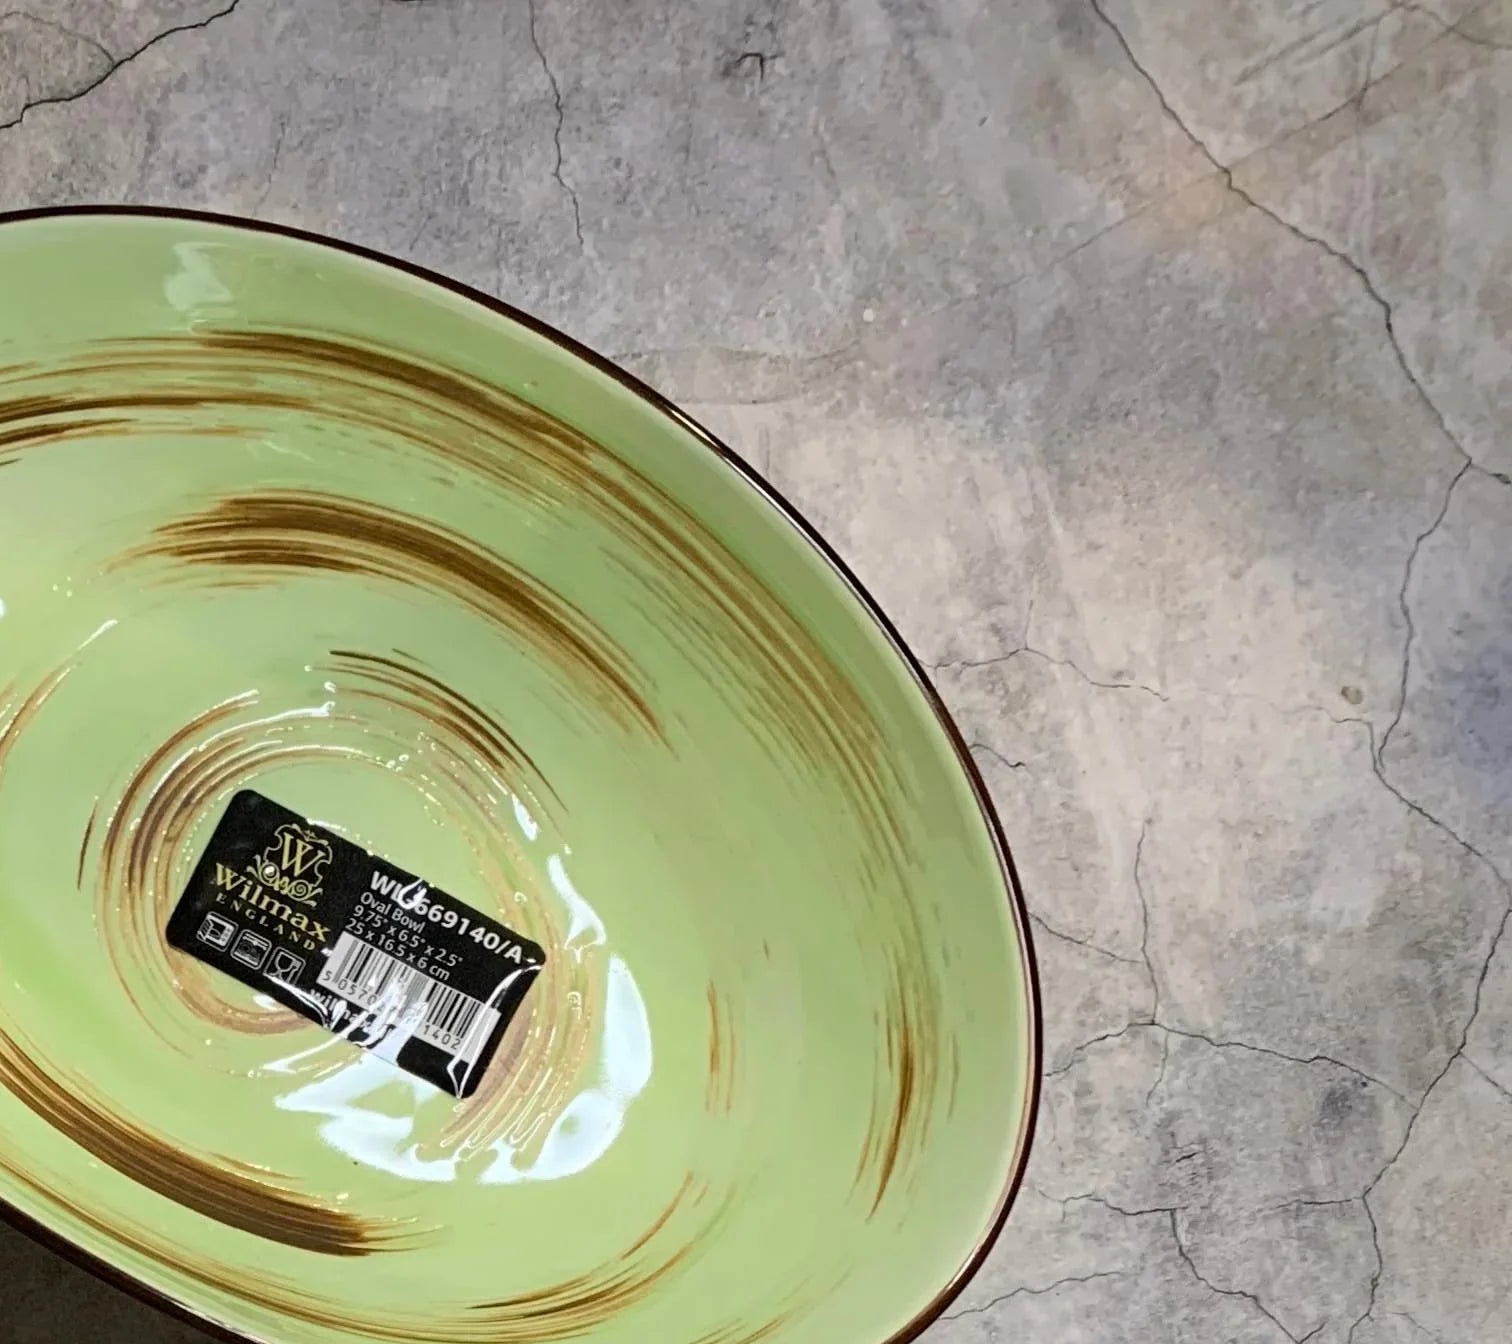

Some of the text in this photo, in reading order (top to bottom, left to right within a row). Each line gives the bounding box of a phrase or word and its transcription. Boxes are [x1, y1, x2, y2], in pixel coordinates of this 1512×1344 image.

[210, 862, 330, 942] Wilmax
[215, 892, 315, 950] ENGLAND
[360, 891, 425, 933] Oval Bowl
[345, 917, 449, 980] 25 x 16.5 x 6 cm
[388, 926, 398, 936] x
[425, 945, 436, 956] x
[322, 970, 332, 981] 5
